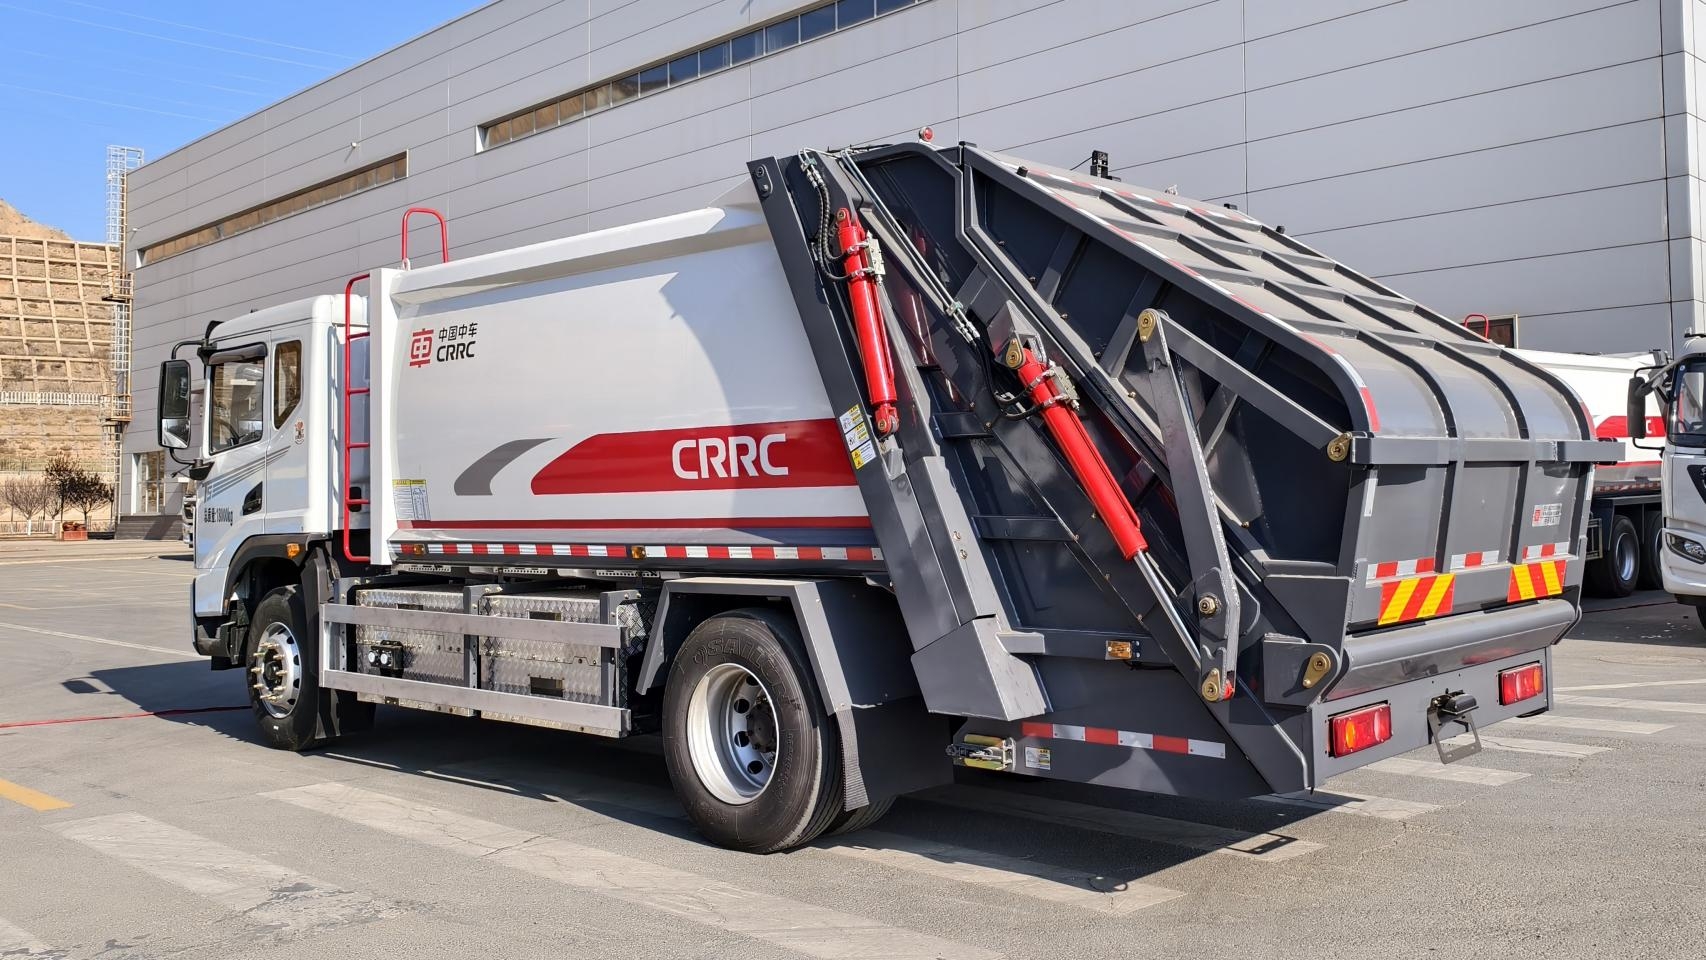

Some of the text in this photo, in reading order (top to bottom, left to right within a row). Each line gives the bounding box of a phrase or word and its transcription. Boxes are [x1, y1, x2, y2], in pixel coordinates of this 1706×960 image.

[438, 322, 478, 342] 中国中车
[436, 341, 476, 362] CRRC
[672, 433, 789, 480] CRRC
